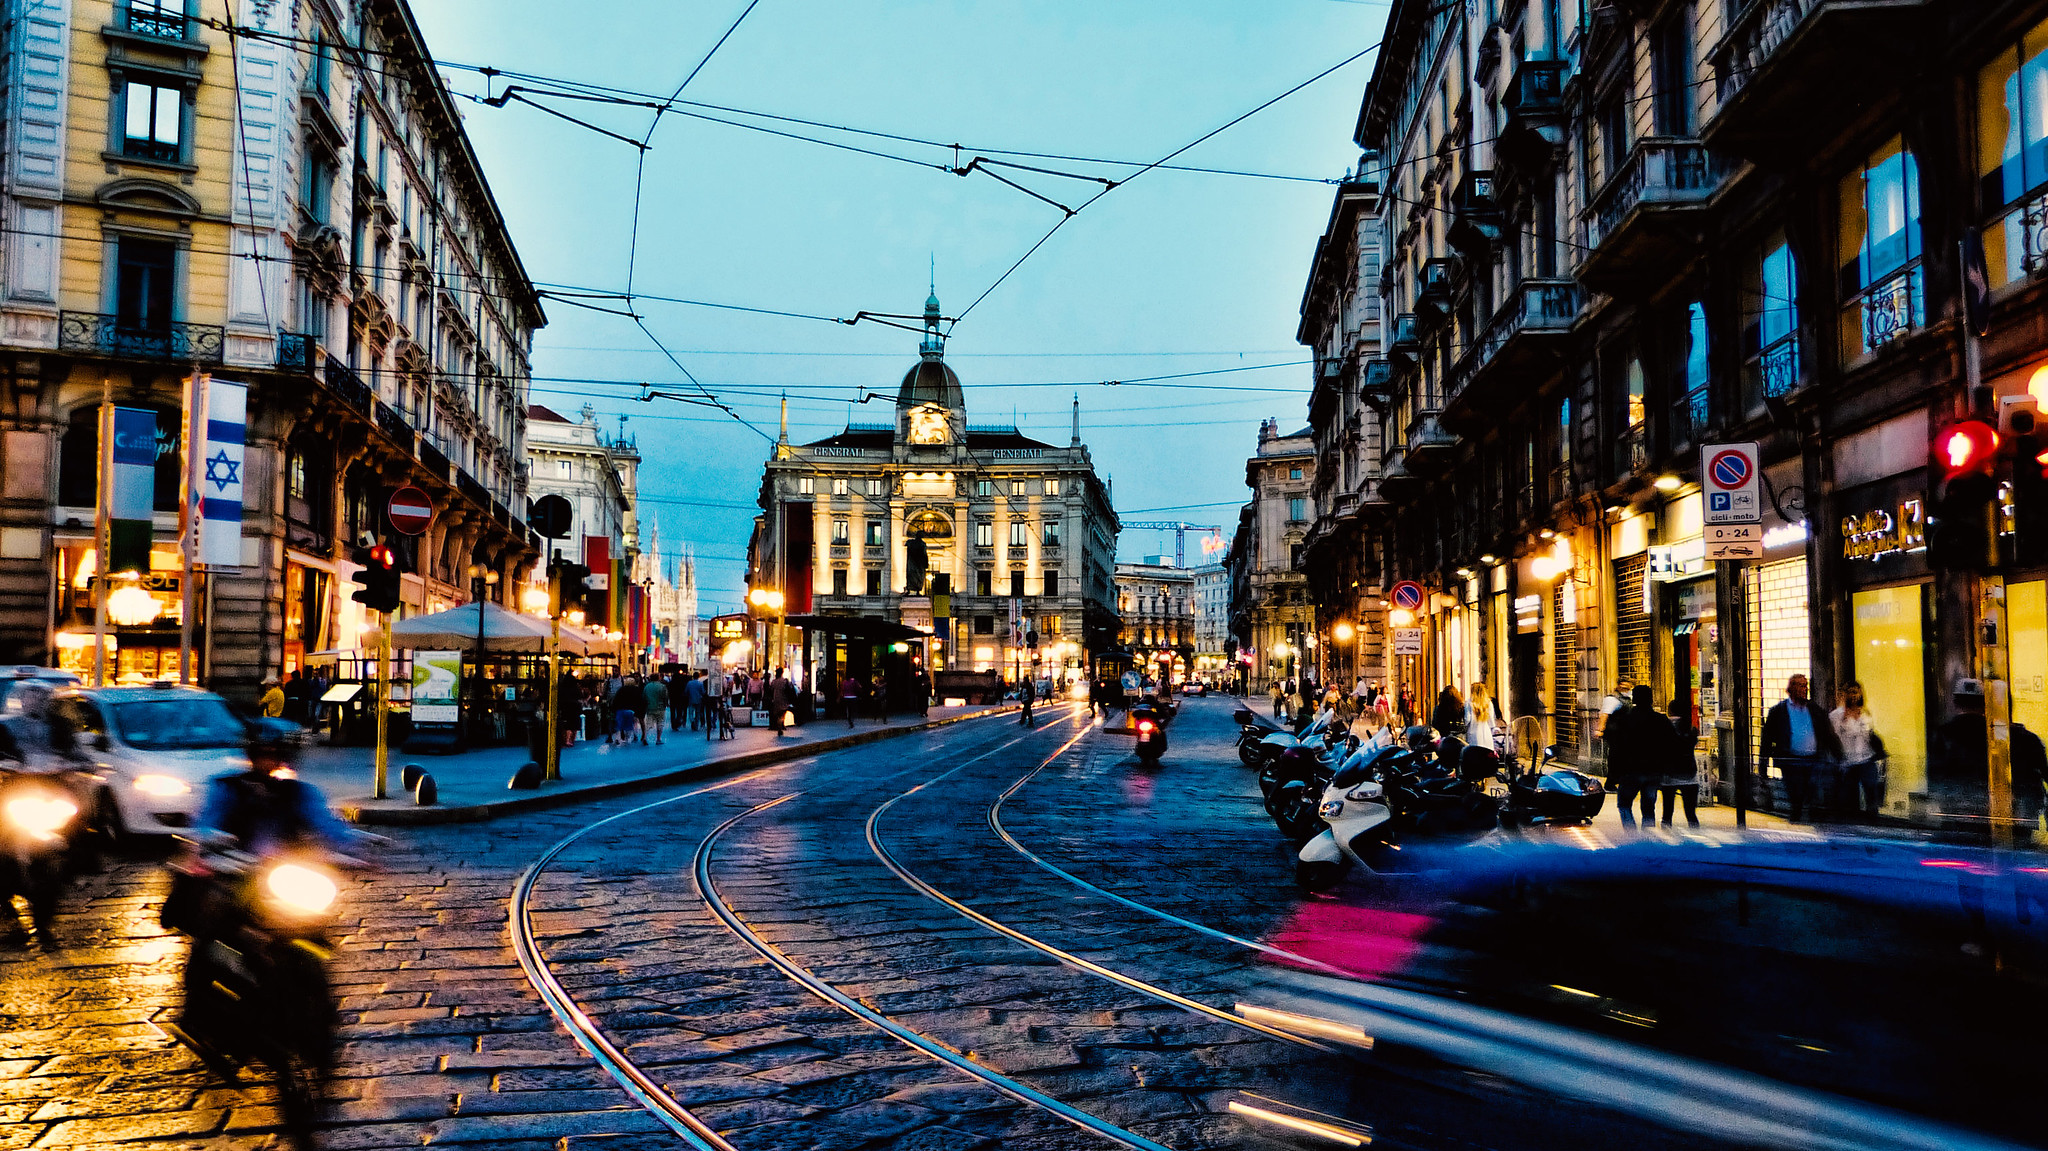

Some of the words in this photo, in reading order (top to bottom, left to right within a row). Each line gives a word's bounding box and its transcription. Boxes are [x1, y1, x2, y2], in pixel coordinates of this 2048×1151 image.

[814, 447, 865, 457] GENERALI
[992, 449, 1043, 458] GENERALI
[1714, 495, 1726, 509] P
[1733, 512, 1754, 520] moto
[1716, 529, 1723, 537] 0
[1734, 529, 1749, 537] 24
